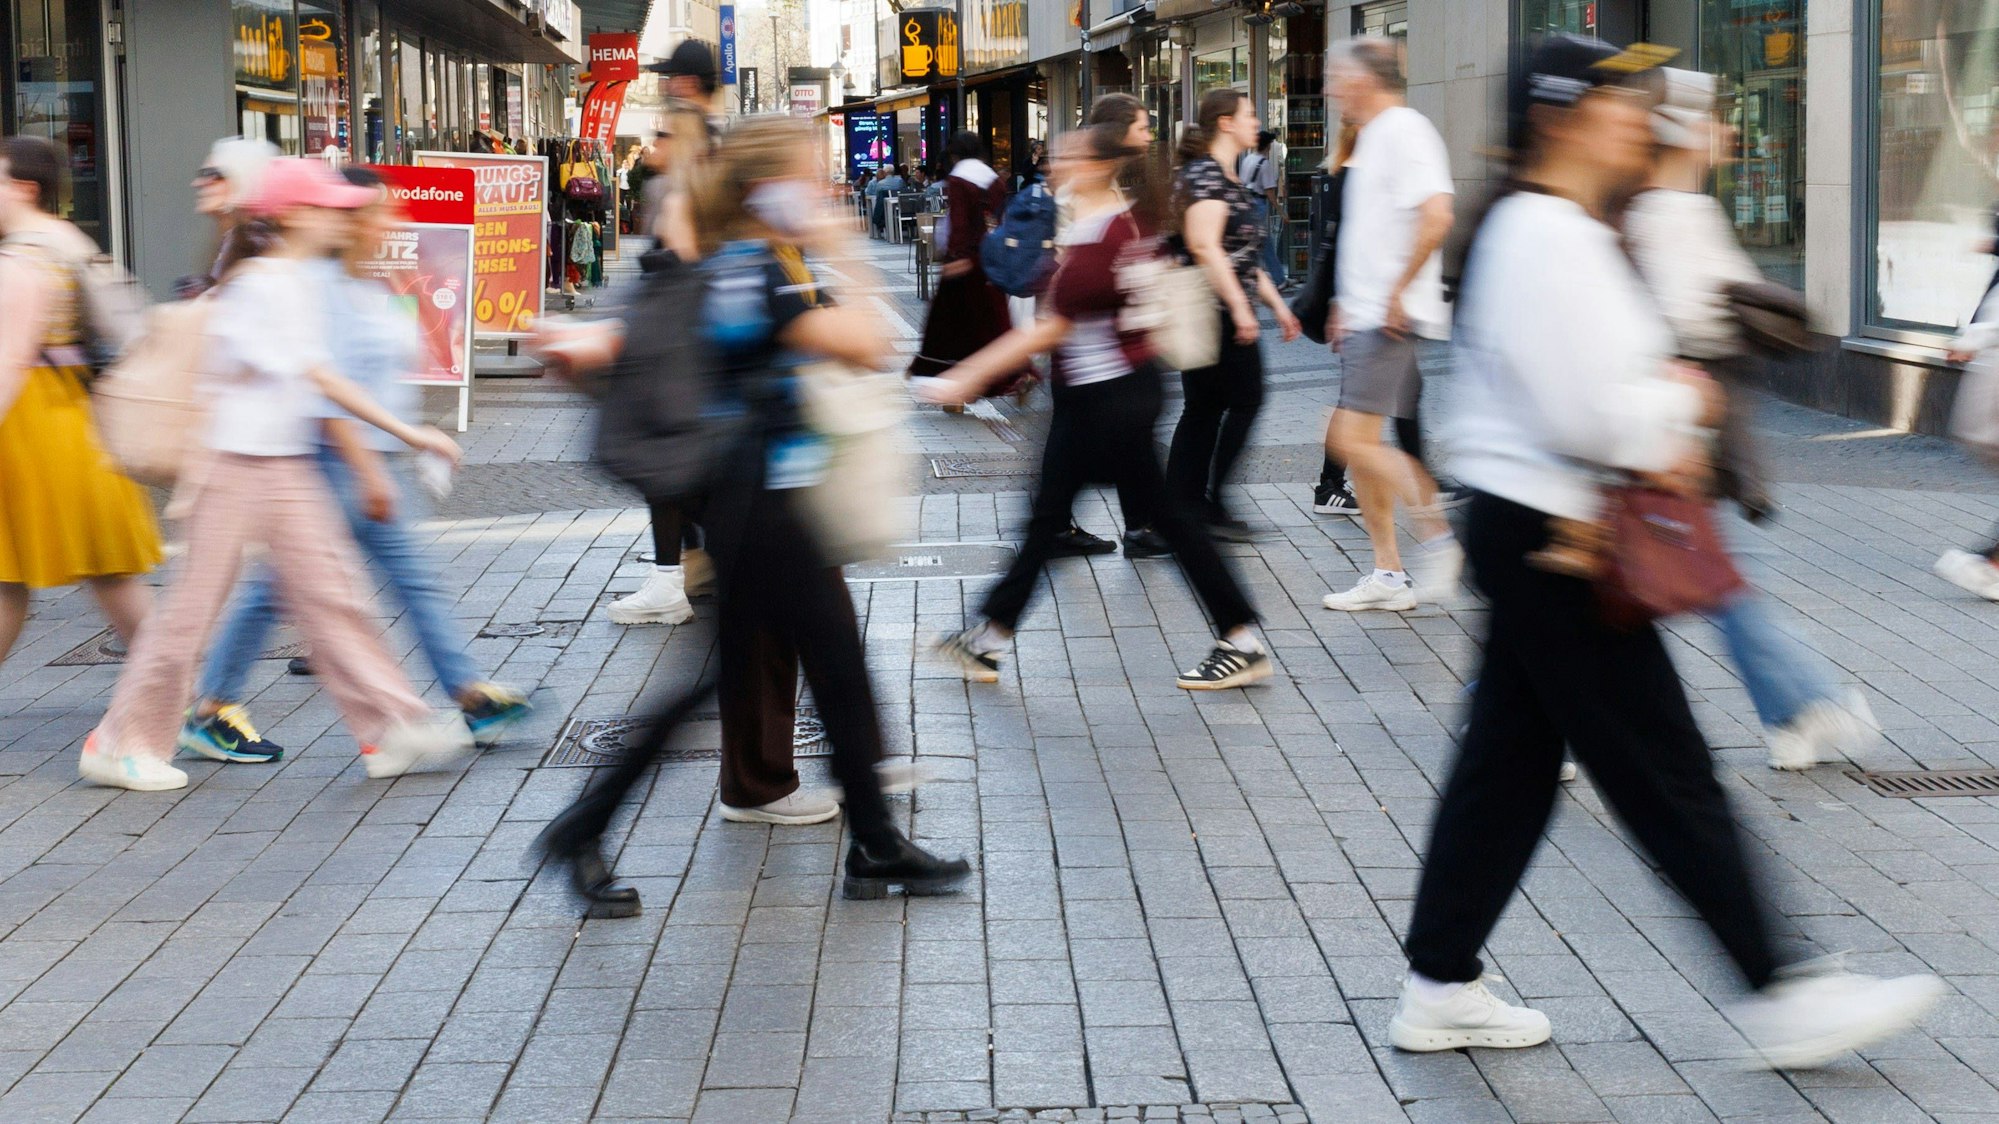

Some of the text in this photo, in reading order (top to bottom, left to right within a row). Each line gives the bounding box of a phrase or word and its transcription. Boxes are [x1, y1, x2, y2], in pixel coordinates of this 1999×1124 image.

[592, 47, 637, 61] HEMA
[724, 43, 735, 74] Apollo
[794, 89, 814, 97] OTTO
[474, 165, 541, 185] UNGS-
[391, 186, 464, 202] vodafone
[474, 181, 538, 204] KAUF
[384, 230, 419, 241] JAHRS
[474, 221, 508, 236] GEN
[373, 240, 419, 260] UTZ
[474, 257, 517, 274] HSEL
